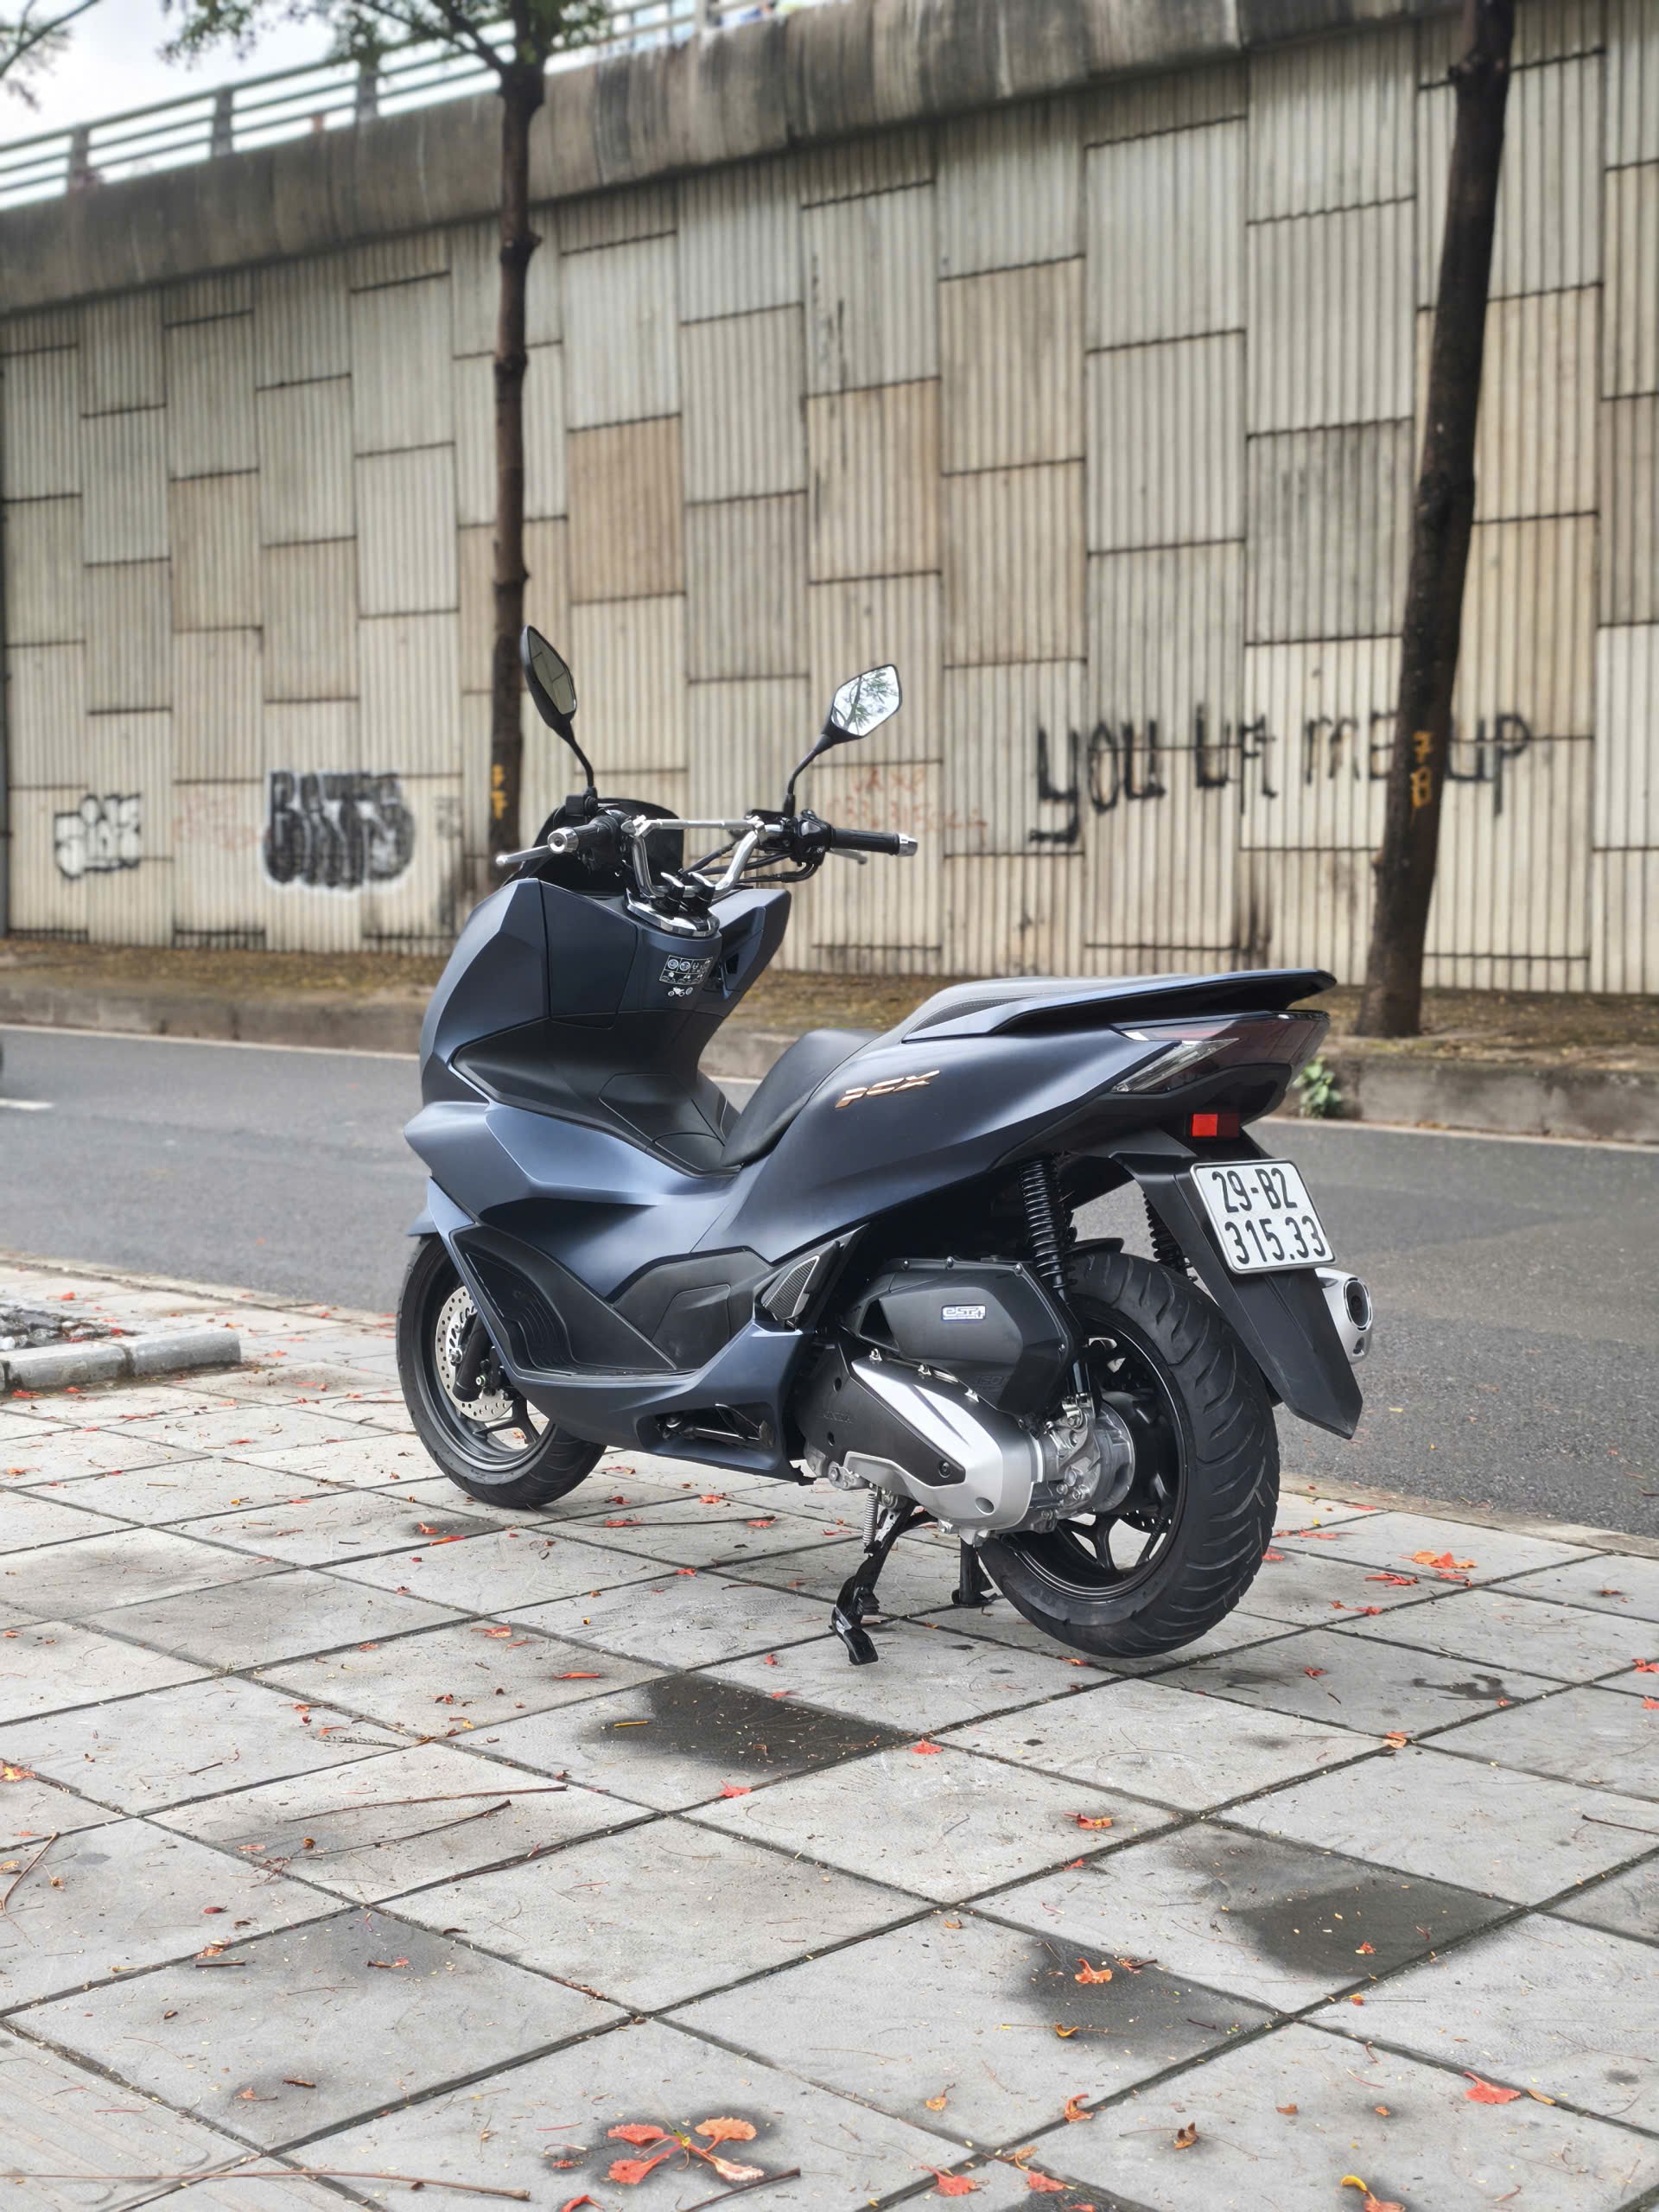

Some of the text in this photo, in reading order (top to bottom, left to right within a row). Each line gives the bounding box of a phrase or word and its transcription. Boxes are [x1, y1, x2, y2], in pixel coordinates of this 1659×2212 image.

[835, 1070, 940, 1109] PCX
[1211, 1167, 1298, 1213] 29-B2
[1224, 1215, 1326, 1264] 315.33
